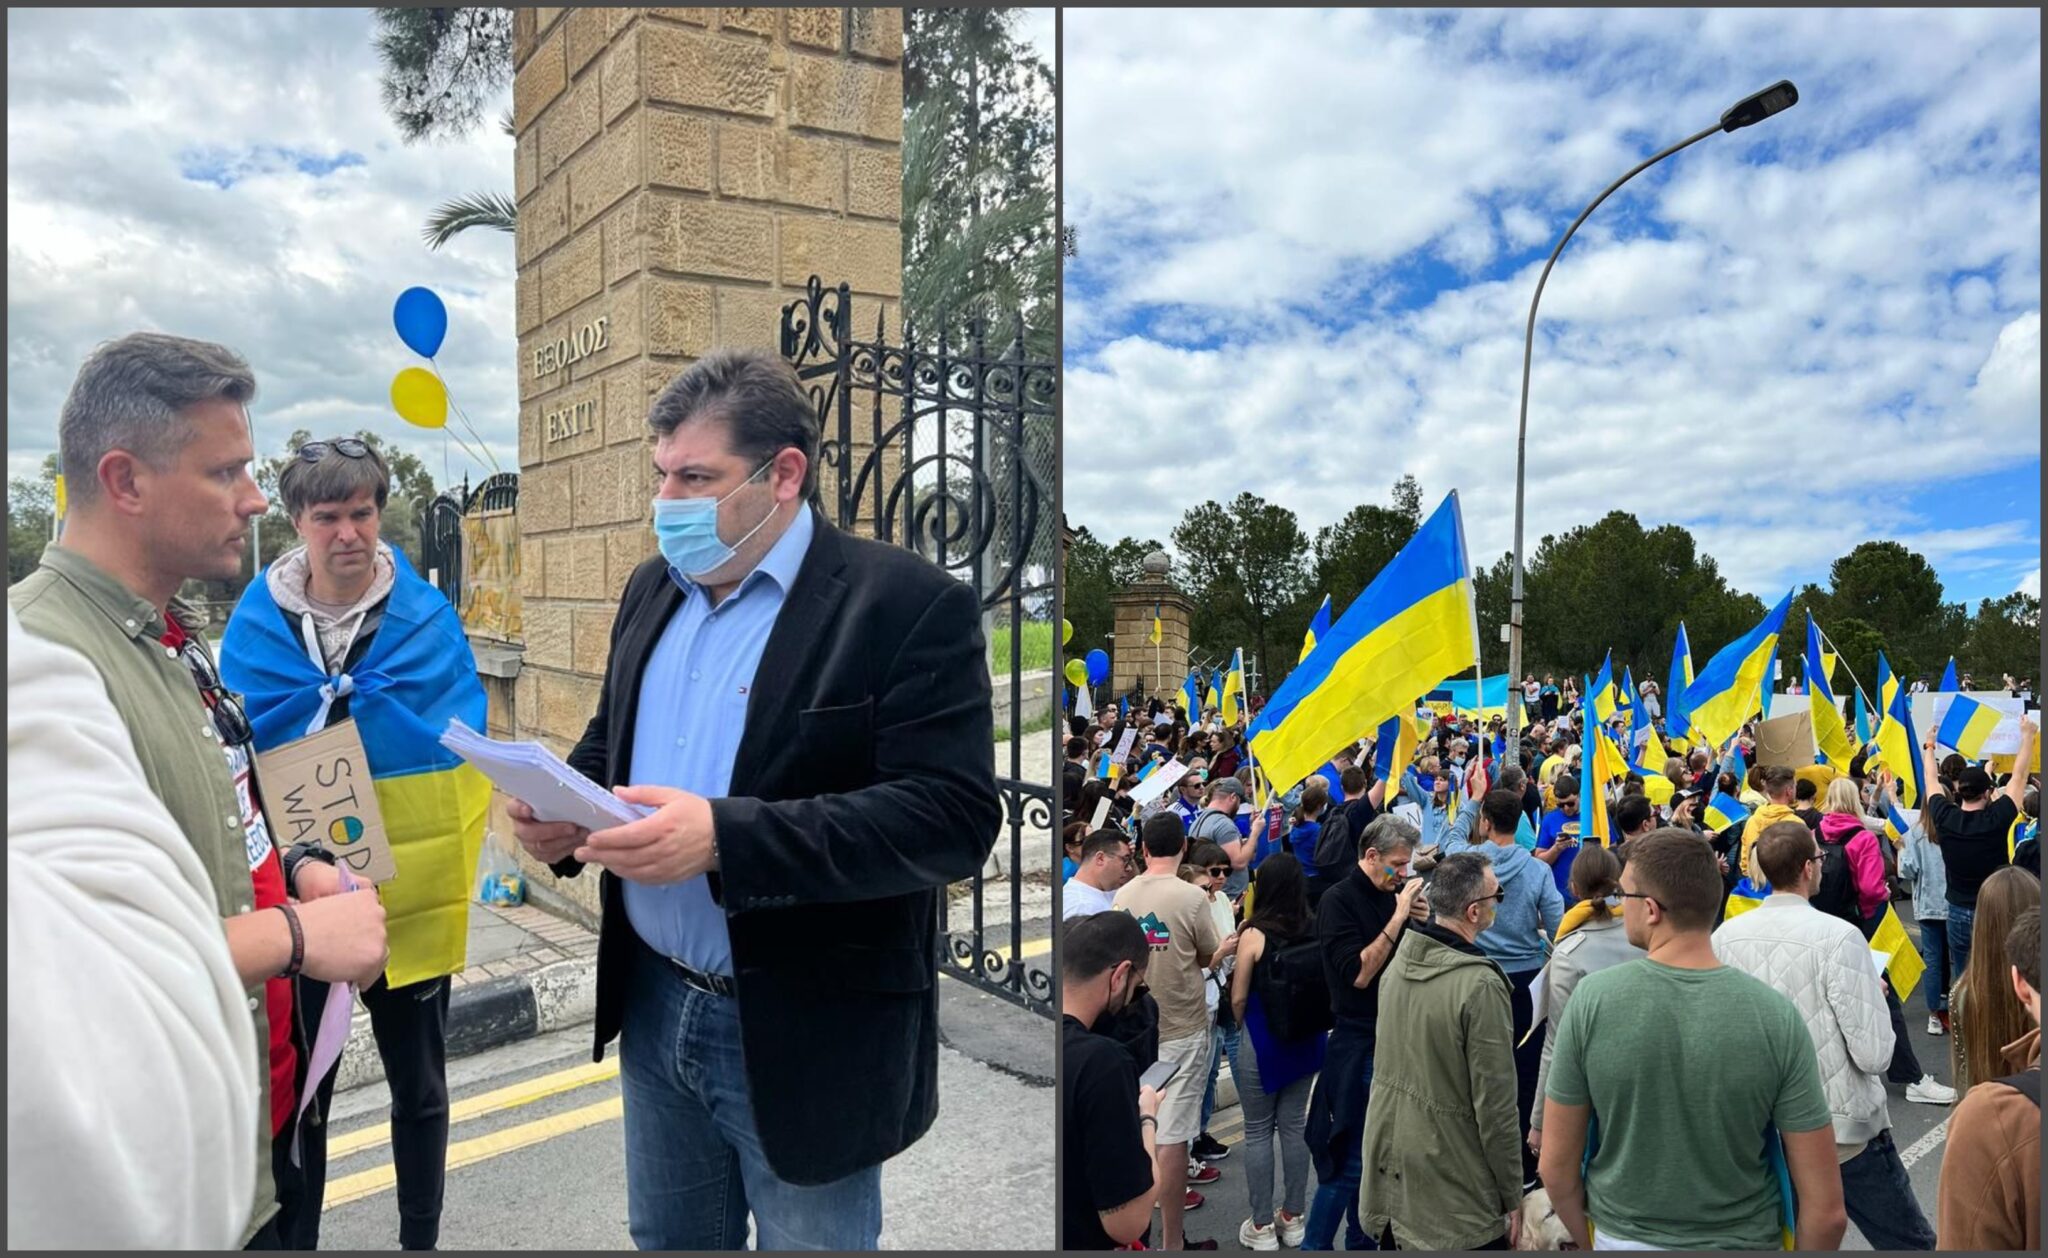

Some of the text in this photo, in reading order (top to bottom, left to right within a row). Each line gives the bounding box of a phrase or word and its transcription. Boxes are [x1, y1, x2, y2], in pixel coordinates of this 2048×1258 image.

[533, 316, 608, 379] ΕΞΟΔΟΣ
[547, 400, 594, 443] EXIT
[315, 757, 371, 870] STOP
